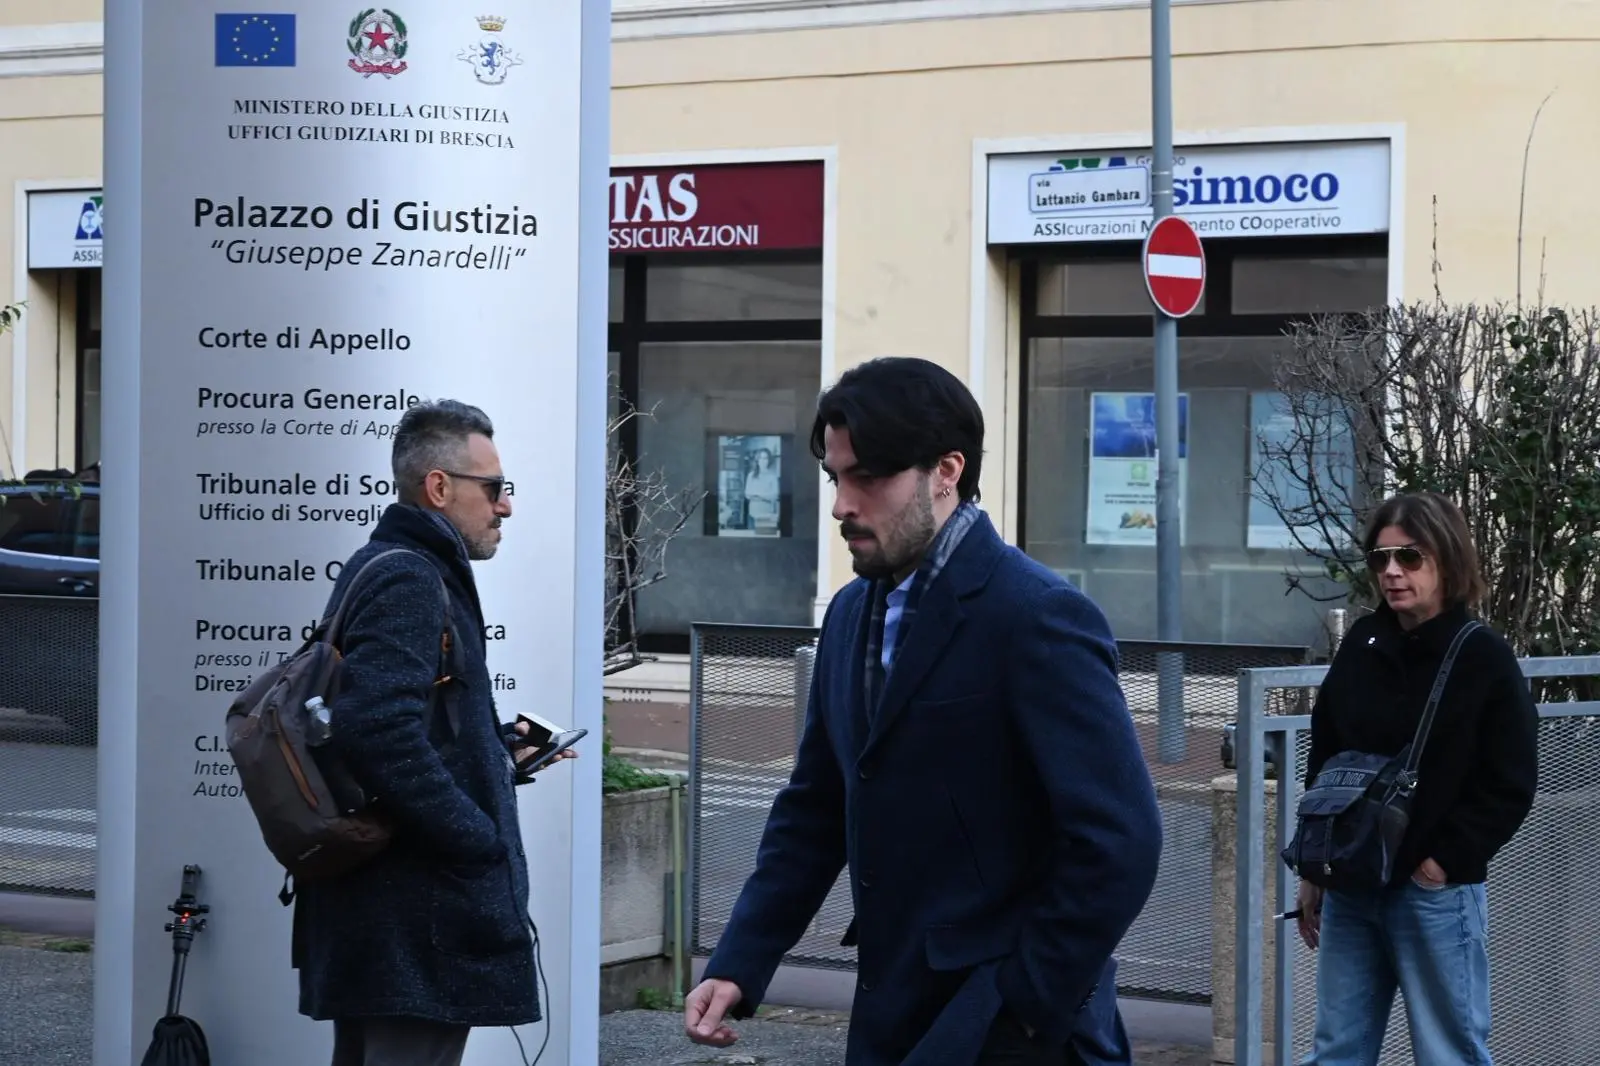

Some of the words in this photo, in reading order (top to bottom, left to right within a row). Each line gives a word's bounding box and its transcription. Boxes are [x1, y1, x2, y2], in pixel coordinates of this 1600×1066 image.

[233, 99, 345, 116] MINISTERO
[350, 102, 414, 119] DELLA
[419, 104, 510, 124] GIUSTIZIA
[227, 124, 292, 141] UFFICI
[297, 126, 409, 143] GIUDIZIARI
[415, 130, 434, 145] DI
[440, 131, 515, 149] BRESCIA
[1036, 193, 1086, 206] Lattanzio
[1092, 189, 1140, 202] Gambara
[1173, 166, 1339, 206] simoco
[194, 196, 333, 229] Palazzo
[346, 198, 380, 230] di
[393, 201, 538, 237] Giustizia
[1034, 219, 1136, 236] ASSIcurazioni
[1240, 215, 1341, 232] COoperativo
[198, 327, 268, 349] Corte
[276, 327, 300, 349] di
[308, 328, 411, 355] Appello
[198, 387, 294, 410] Procura
[303, 388, 420, 410] Generale
[196, 421, 255, 438] presso
[260, 419, 277, 436] la
[283, 420, 334, 436] Corte
[340, 420, 358, 436] di
[196, 472, 317, 496] Tribunale
[325, 473, 349, 496] di
[199, 503, 265, 522] Ufficio
[271, 503, 291, 522] di
[196, 558, 317, 582] Tribunale
[196, 619, 292, 642] Procura
[194, 653, 253, 670] presso
[258, 650, 271, 667] il
